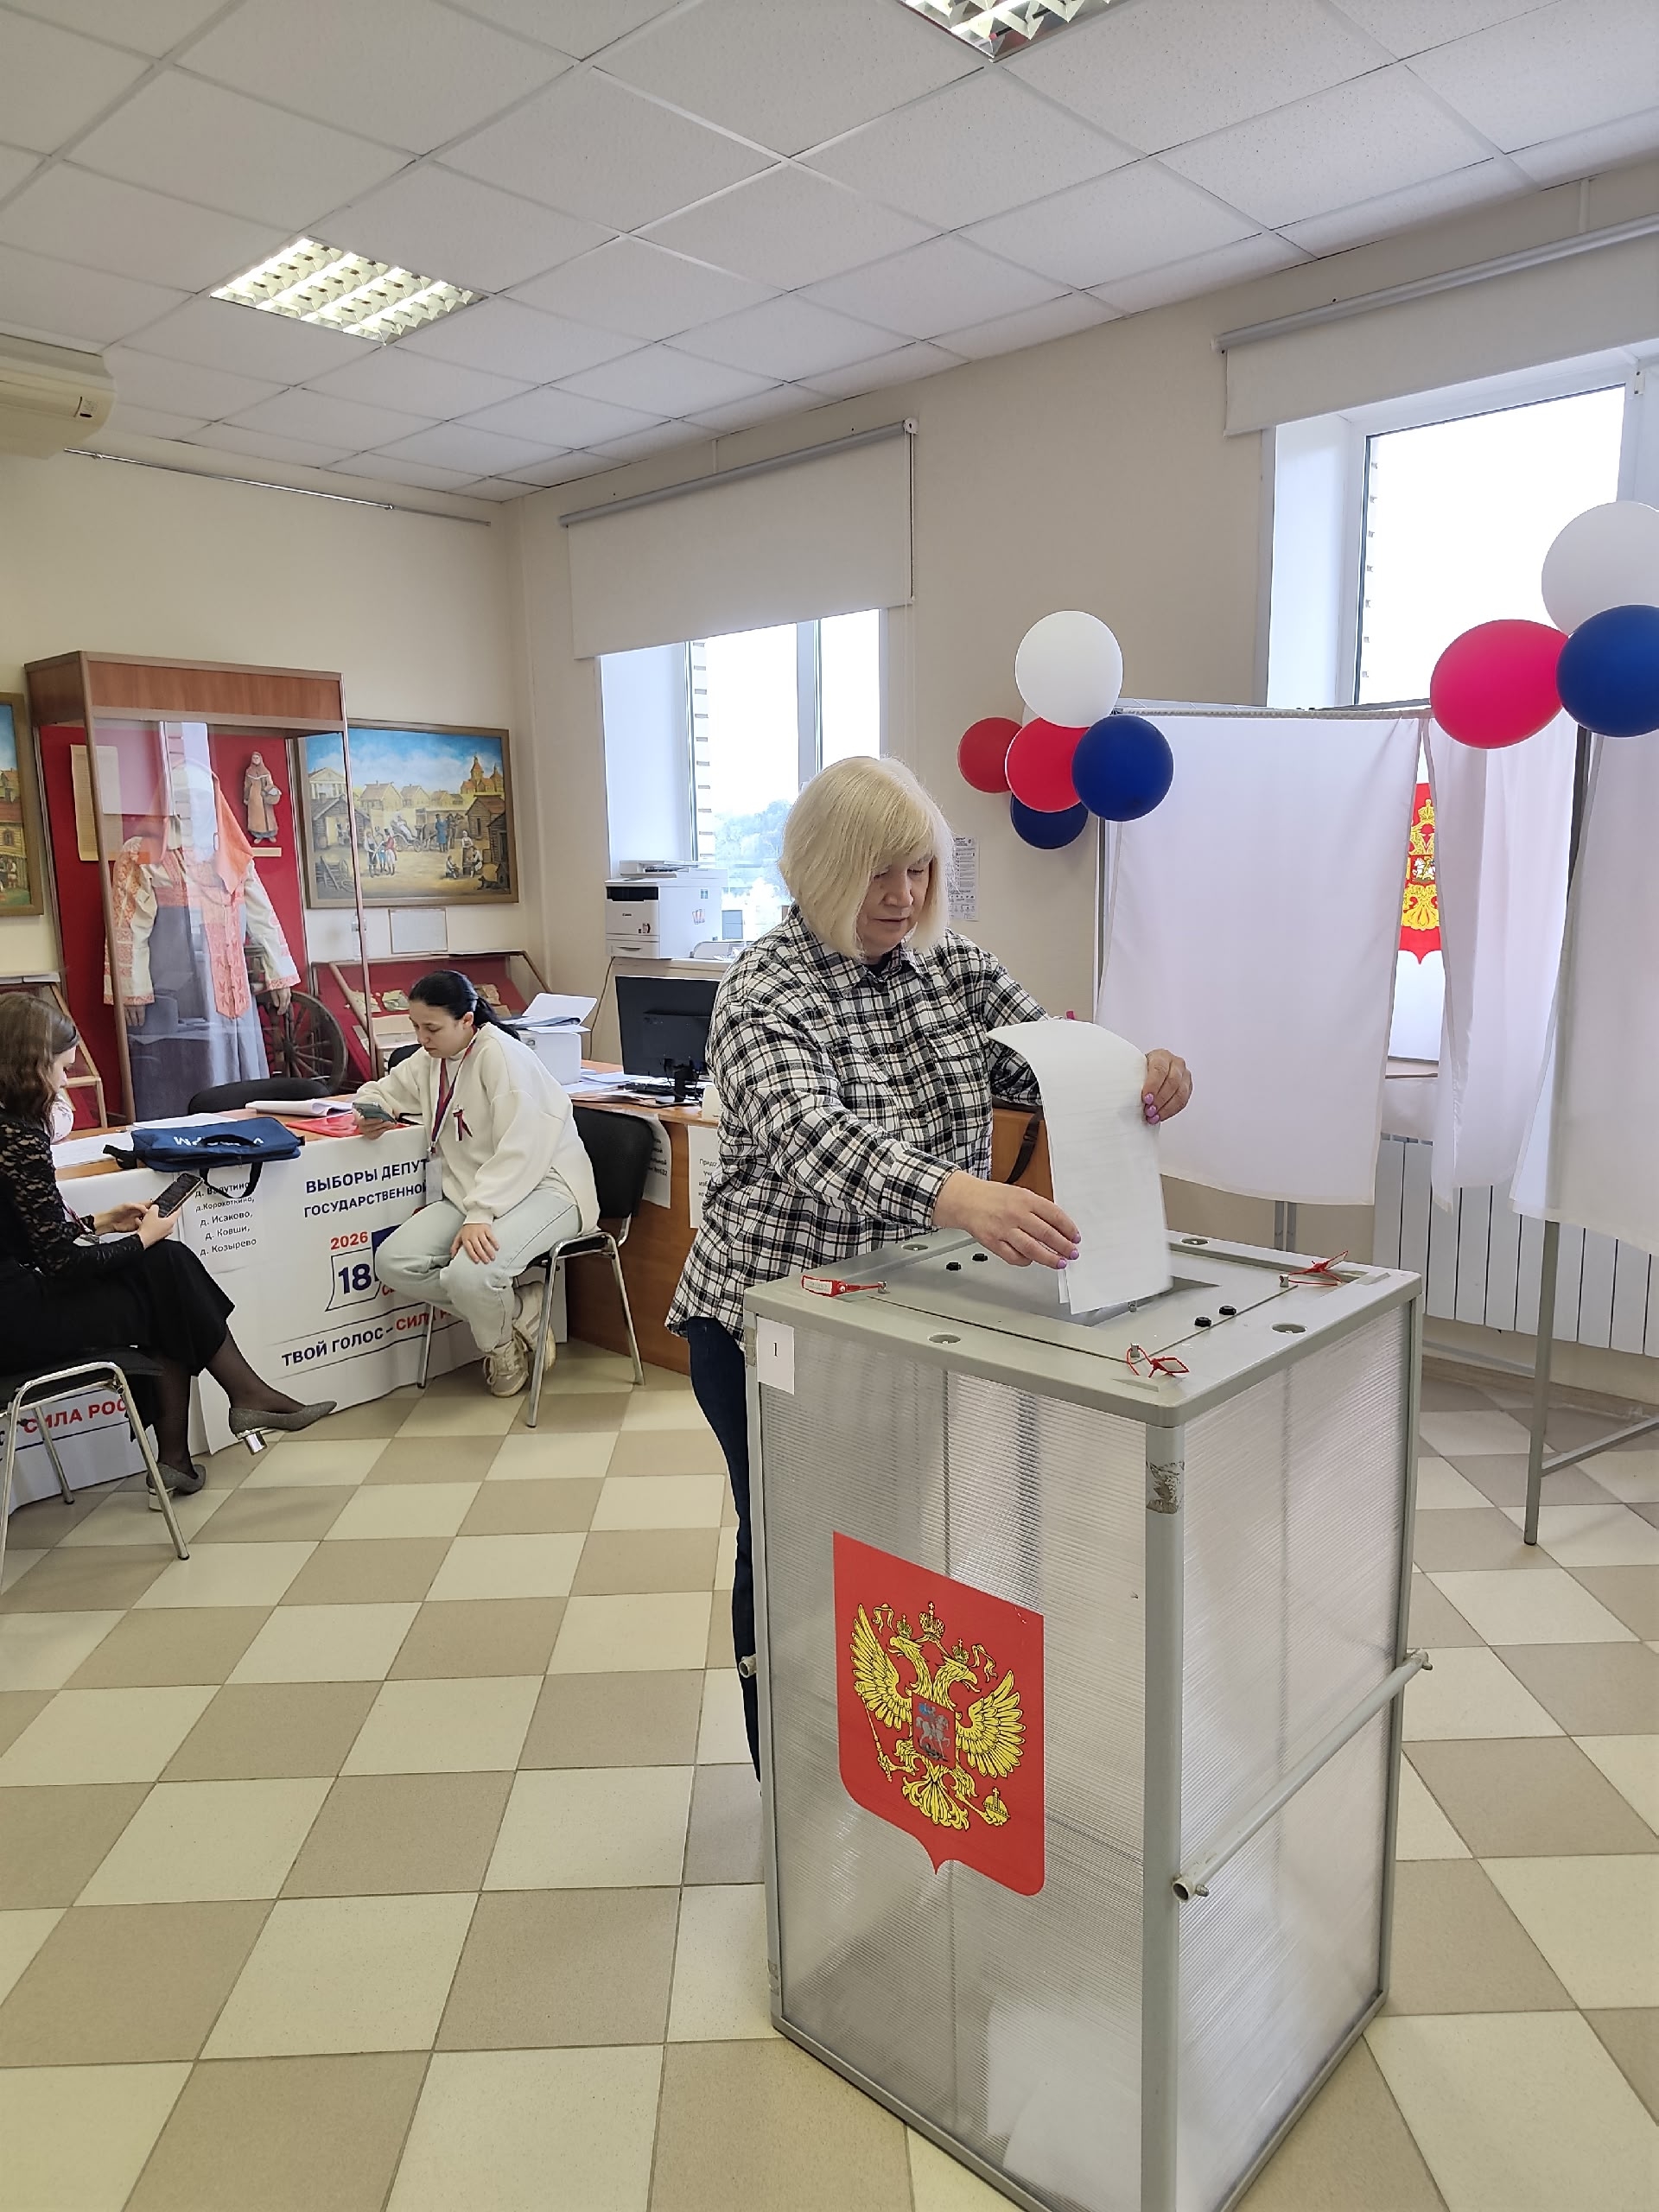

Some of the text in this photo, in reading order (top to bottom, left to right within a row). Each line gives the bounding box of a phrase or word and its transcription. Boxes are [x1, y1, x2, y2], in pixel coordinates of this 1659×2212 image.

[306, 1158, 429, 1194] ВЫБОРЫ ДЕПУТ
[200, 1211, 253, 1228] д. Исаково,
[205, 1226, 251, 1241] д. Ковши,
[330, 1231, 369, 1250] 2026
[212, 1239, 257, 1253] Козырево
[338, 1263, 372, 1294] 18
[282, 1341, 327, 1366] ТВОЙ
[332, 1327, 384, 1353] ГОЛОС
[396, 1312, 436, 1332] СИЛ
[772, 1342, 779, 1357] 1
